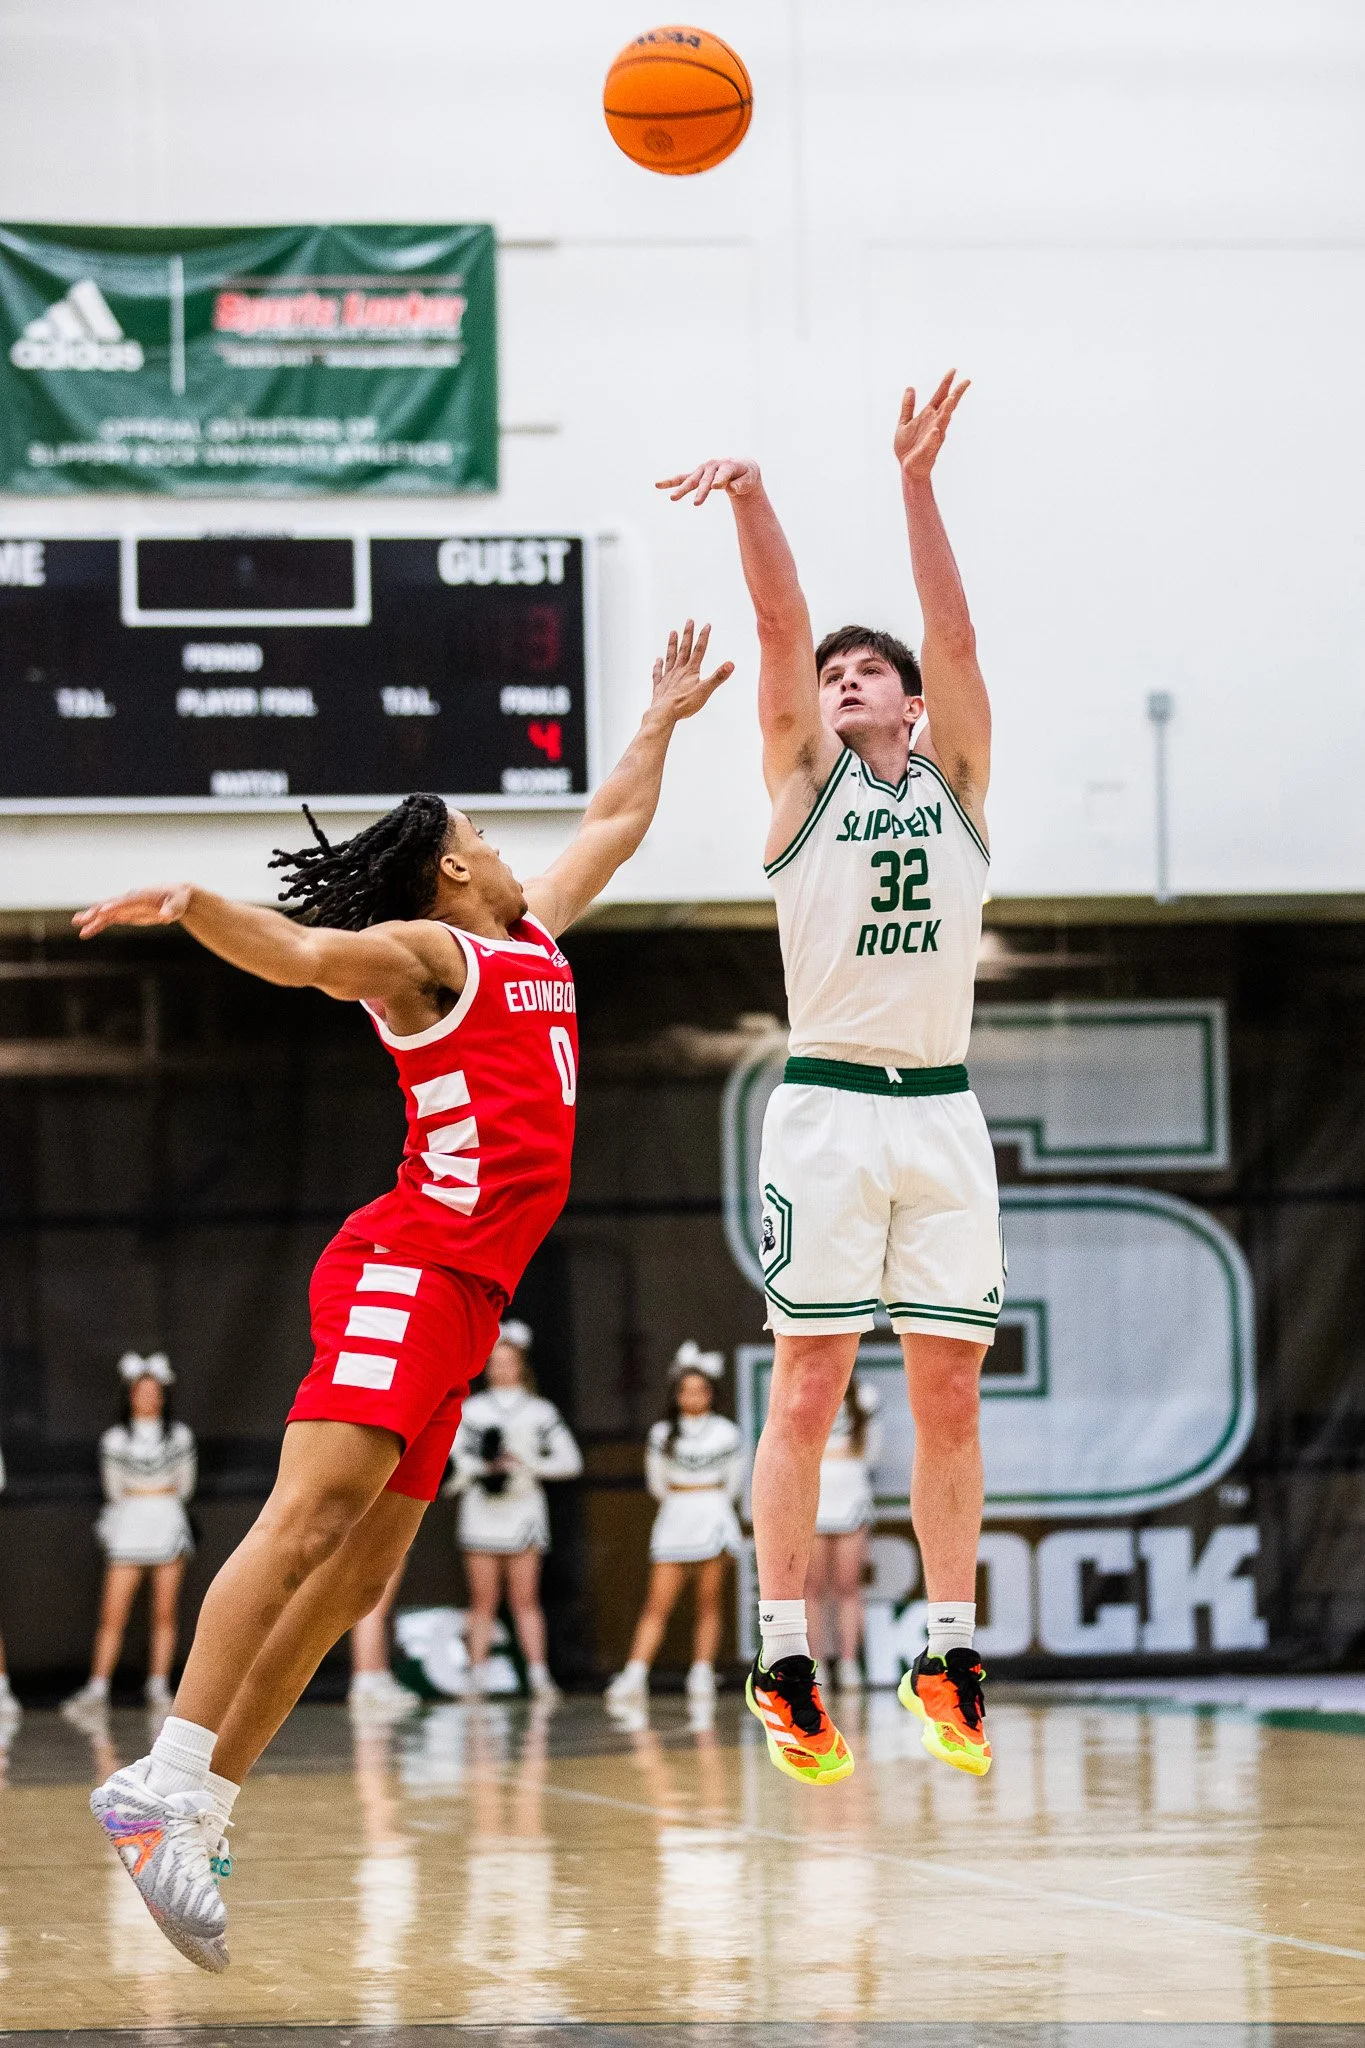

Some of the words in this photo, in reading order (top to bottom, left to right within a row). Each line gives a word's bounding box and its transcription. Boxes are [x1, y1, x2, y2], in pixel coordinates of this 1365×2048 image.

[10, 336, 145, 372] adidas
[437, 539, 571, 586] GUEST
[181, 642, 263, 672] PERIOD
[175, 686, 260, 718] PLAYER
[499, 684, 571, 716] FOULS
[527, 719, 562, 761] 4
[871, 847, 931, 912] 32
[856, 918, 942, 956] ROCK
[549, 1026, 576, 1107] 0
[738, 1522, 1270, 1662] OCK
